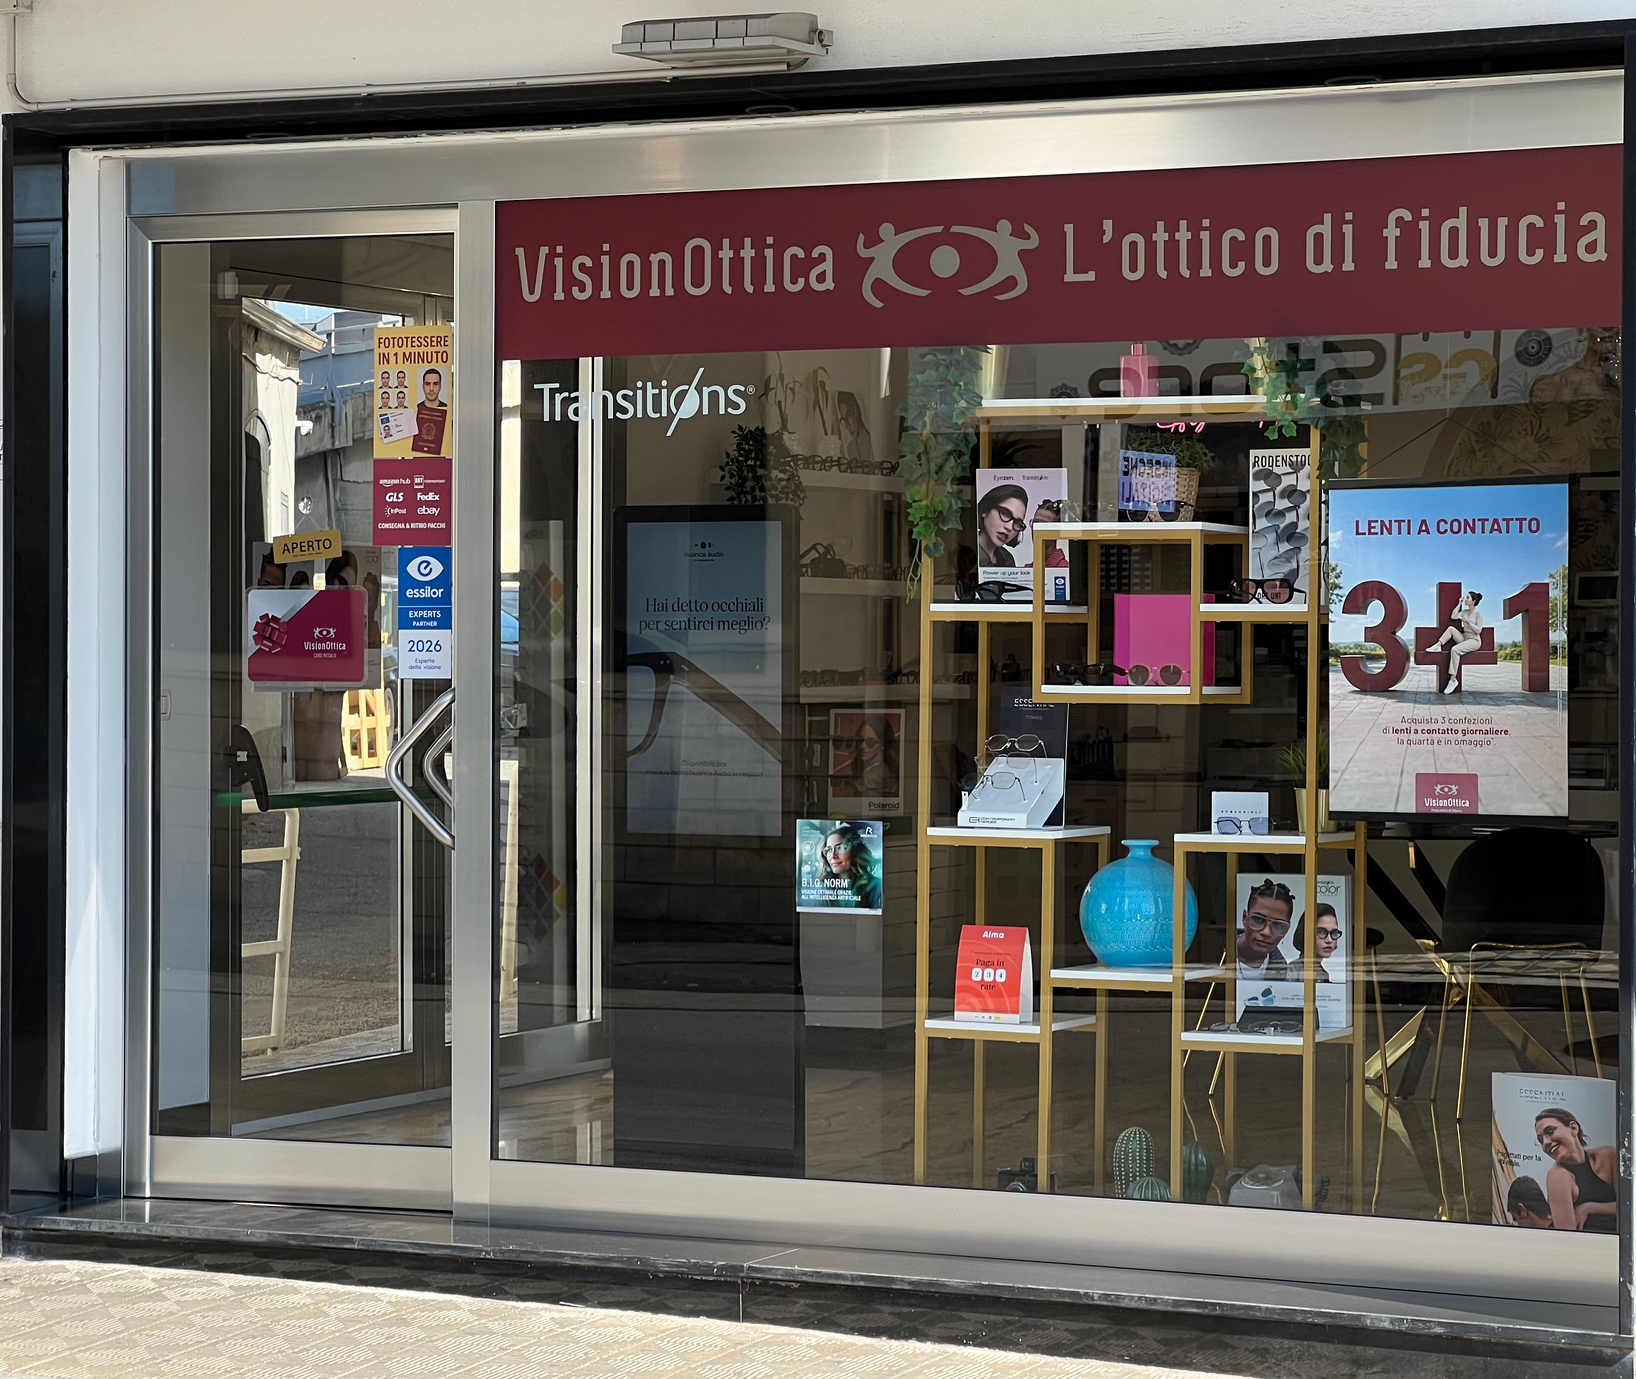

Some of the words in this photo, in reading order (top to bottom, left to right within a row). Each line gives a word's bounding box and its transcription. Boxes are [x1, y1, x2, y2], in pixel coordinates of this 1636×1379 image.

[1063, 218, 1280, 282] L'ottico
[1305, 212, 1355, 273] di
[1383, 201, 1609, 270] fiducia
[515, 236, 836, 303] VisionOttica
[378, 335, 449, 348] FOTOTESSERE
[378, 352, 390, 365] IN
[393, 352, 399, 365] 1
[402, 350, 449, 364] MINUTO
[400, 477, 411, 485] hub
[385, 492, 404, 502] GLS
[417, 492, 440, 501] FedEx
[417, 505, 441, 516] ebay
[1355, 518, 1412, 536] LENTI
[1416, 518, 1431, 535] A
[1435, 516, 1541, 535] CONTATTO
[282, 538, 332, 555] APERTO
[406, 586, 444, 598] essilor
[646, 598, 668, 613] Hai
[671, 597, 709, 613] detto
[711, 597, 764, 613] occhiali
[408, 610, 441, 618] EXPERTS
[639, 618, 662, 635] per
[664, 616, 714, 631] sentirci
[717, 615, 771, 635] meglio?
[304, 641, 346, 651] VisionOttica
[407, 639, 442, 653] 2026
[1401, 716, 1439, 727] Acquista
[1440, 716, 1446, 724] 3
[1448, 716, 1493, 725] confezioni
[1382, 726, 1390, 735] di
[1391, 726, 1412, 735] lenti
[1421, 726, 1460, 735] contatto
[1397, 736, 1405, 746] la
[1406, 737, 1433, 748] quarta
[1443, 737, 1452, 746] in
[682, 760, 715, 768] Disponibile
[868, 801, 900, 809] Polaroid
[1424, 797, 1470, 807] VisionOttica
[801, 878, 822, 888] B.I.G.
[982, 930, 1005, 939] Alma
[975, 959, 995, 968] Paga
[996, 959, 1005, 967] in
[980, 983, 996, 991] rate
[1523, 1153, 1534, 1162] per
[1535, 1154, 1542, 1162] la
